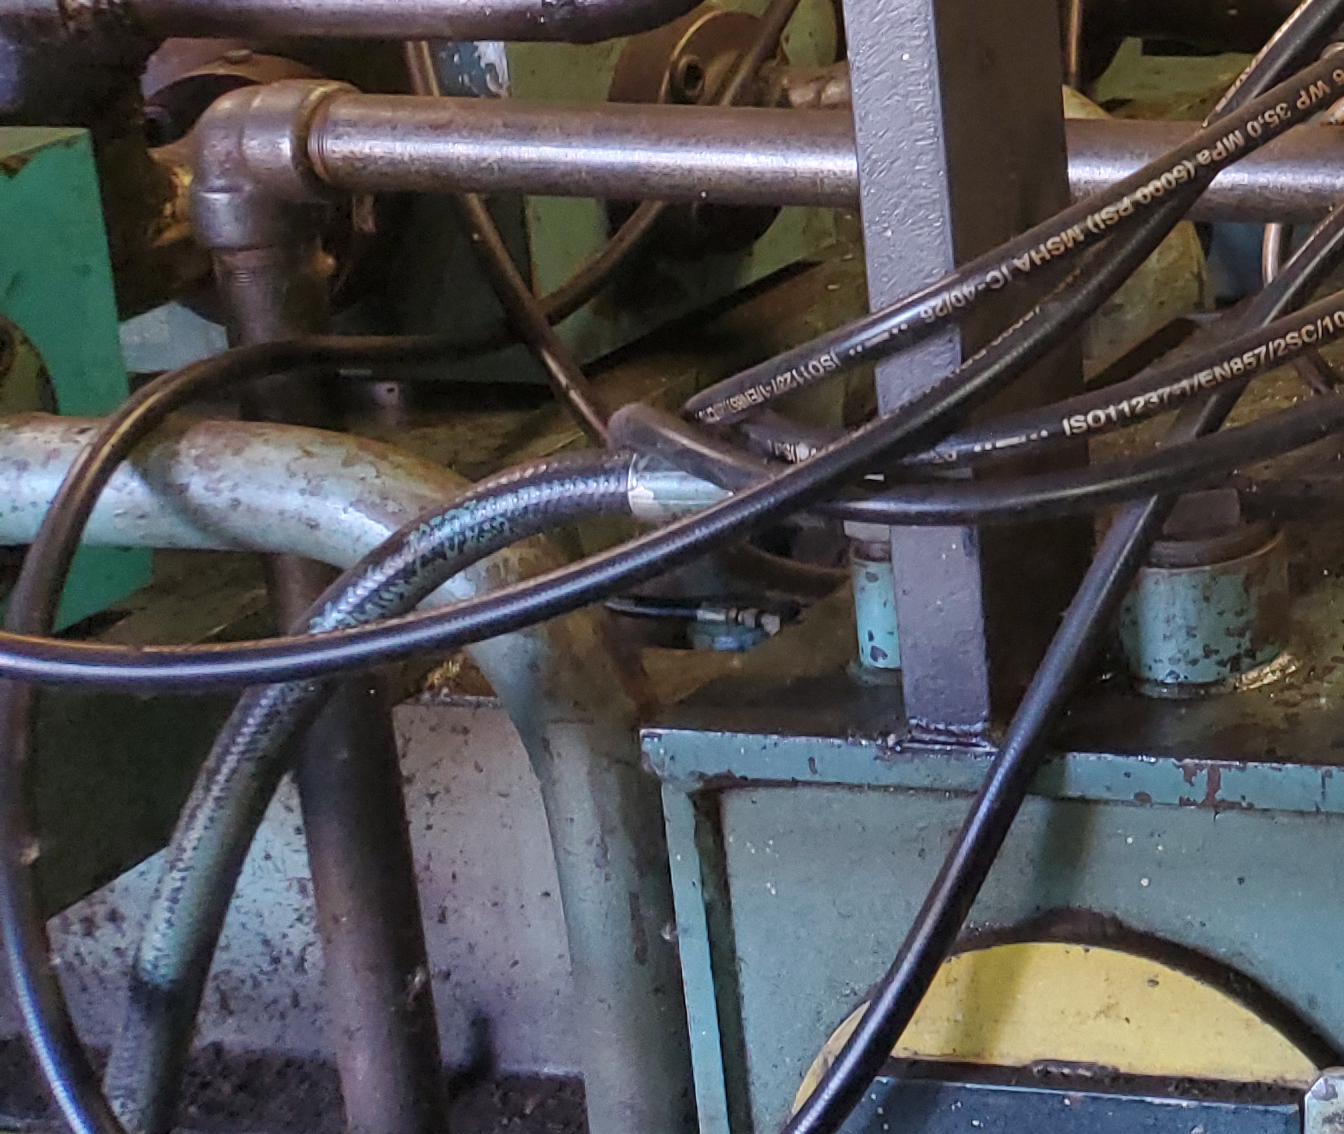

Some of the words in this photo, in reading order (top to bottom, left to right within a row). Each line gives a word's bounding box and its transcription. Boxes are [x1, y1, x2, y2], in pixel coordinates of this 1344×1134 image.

[1295, 79, 1331, 110] WP
[1246, 101, 1291, 136] 35,0
[1196, 128, 1245, 165] MPa
[1132, 159, 1196, 203] (5000
[1085, 195, 1135, 234] PSI)
[1011, 224, 1085, 272] MSHA
